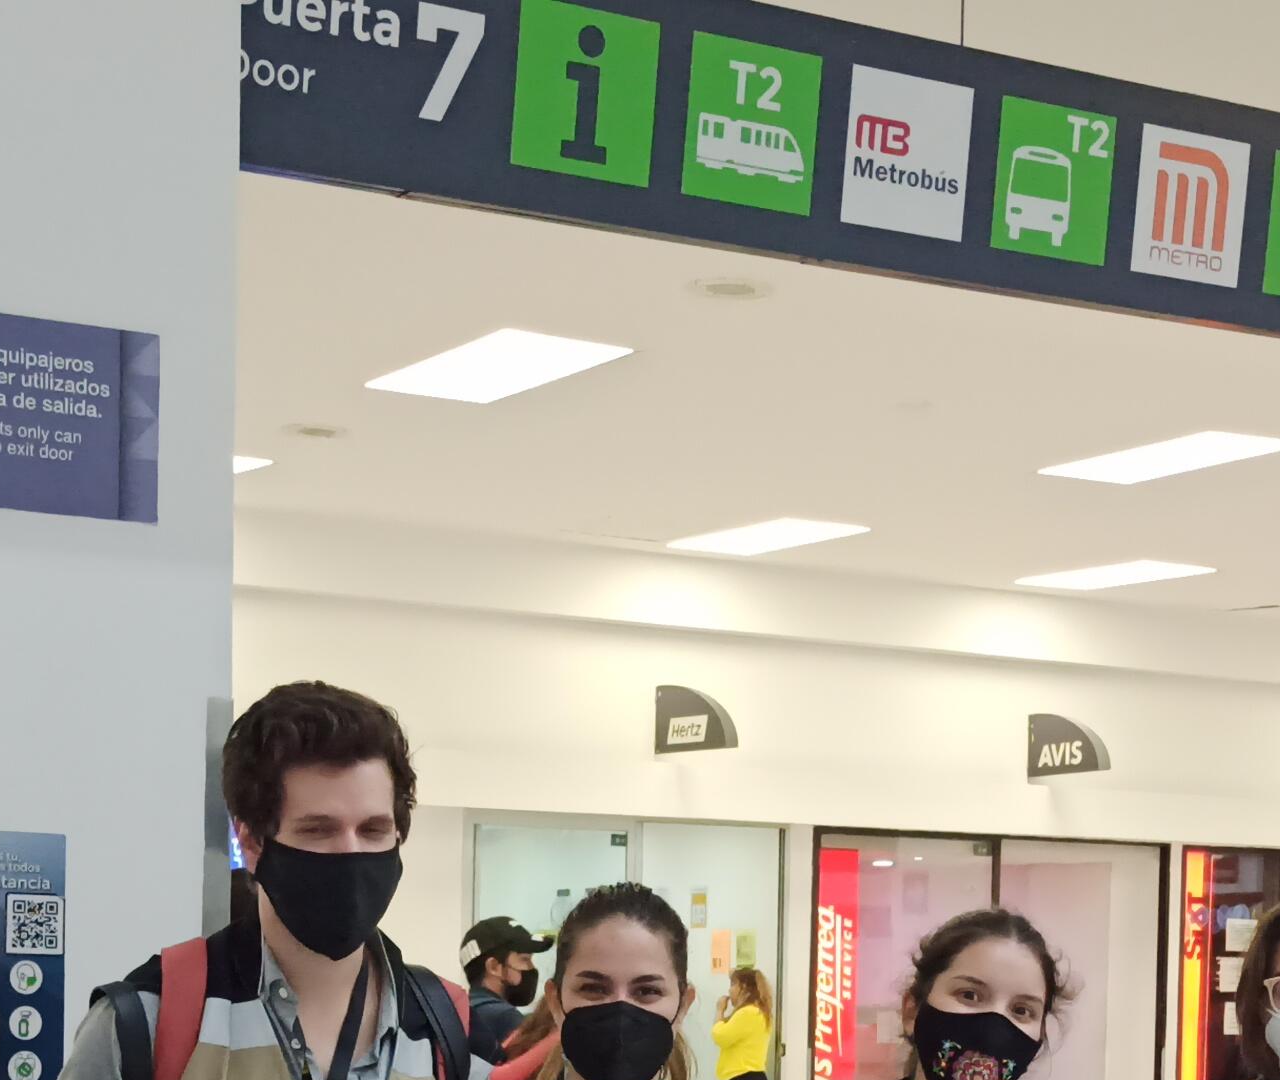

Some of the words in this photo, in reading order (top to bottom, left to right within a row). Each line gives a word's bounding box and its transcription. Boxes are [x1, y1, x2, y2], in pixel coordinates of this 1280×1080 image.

[241, 0, 400, 47] uerta
[416, 1, 486, 121] 7
[729, 59, 783, 112] T2
[1066, 114, 1111, 158] T2
[852, 156, 960, 195] Metrobús
[1149, 245, 1223, 272] METRO
[21, 371, 111, 398] utilizados
[12, 391, 37, 411] de
[42, 397, 103, 418] salida.
[17, 424, 50, 444] only
[54, 429, 82, 445] can
[7, 441, 35, 457] exit
[39, 443, 74, 461] door
[671, 722, 703, 738] Hertz
[1038, 740, 1083, 768] AVIS
[842, 917, 854, 1000] SERVICE
[815, 905, 844, 1053] Preferred
